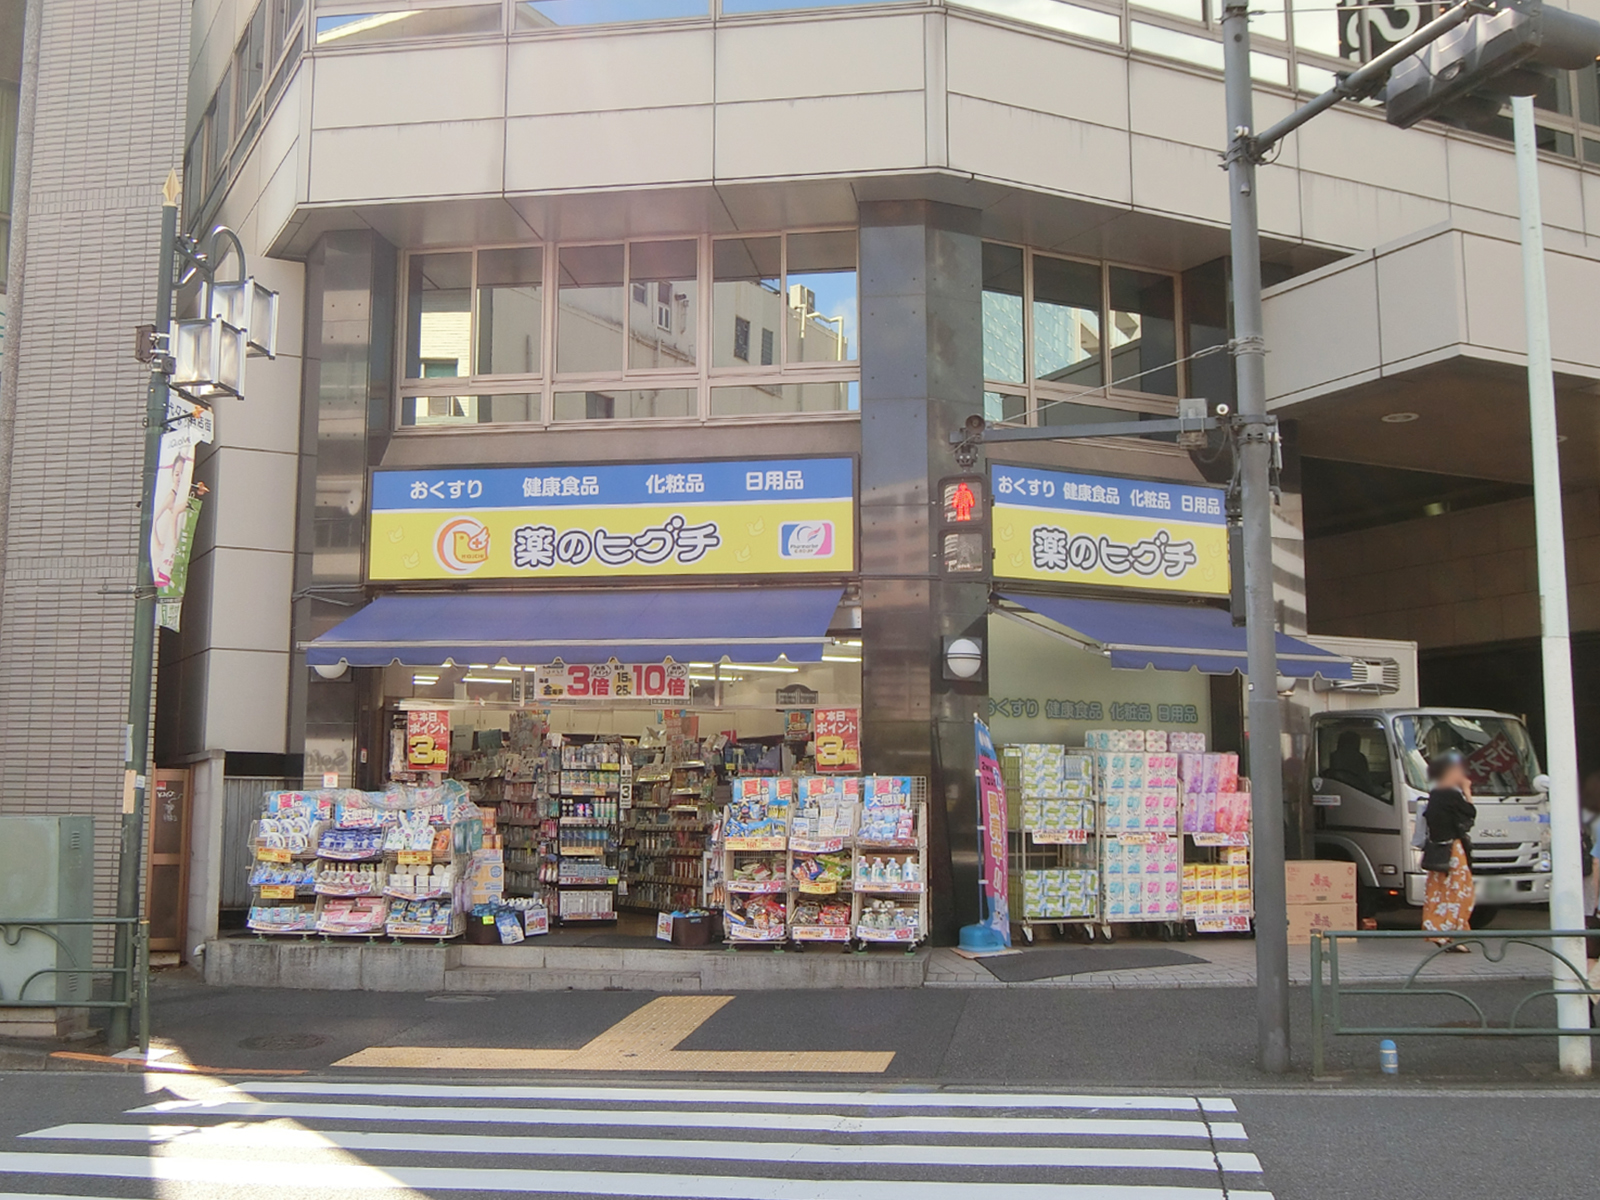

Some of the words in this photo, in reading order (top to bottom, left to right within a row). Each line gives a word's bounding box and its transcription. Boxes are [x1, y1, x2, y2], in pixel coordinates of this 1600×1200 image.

[410, 479, 483, 500] おくすり
[522, 476, 599, 497] 健康食品
[645, 473, 705, 494] 化粧品
[745, 470, 804, 491] 日用品
[998, 476, 1055, 498] おくすり
[1062, 482, 1120, 505] 健康食品
[1129, 489, 1171, 510] 化粧品
[1181, 495, 1221, 515] 日用品
[513, 514, 720, 568] 薬のヒグチ
[1031, 527, 1197, 577] 薬のヒグチ
[816, 721, 857, 734] ポイント
[1045, 701, 1103, 721] 健康食品
[1110, 703, 1152, 722] 化粧品
[1157, 705, 1198, 724] 日用品
[409, 722, 448, 735] ポイント
